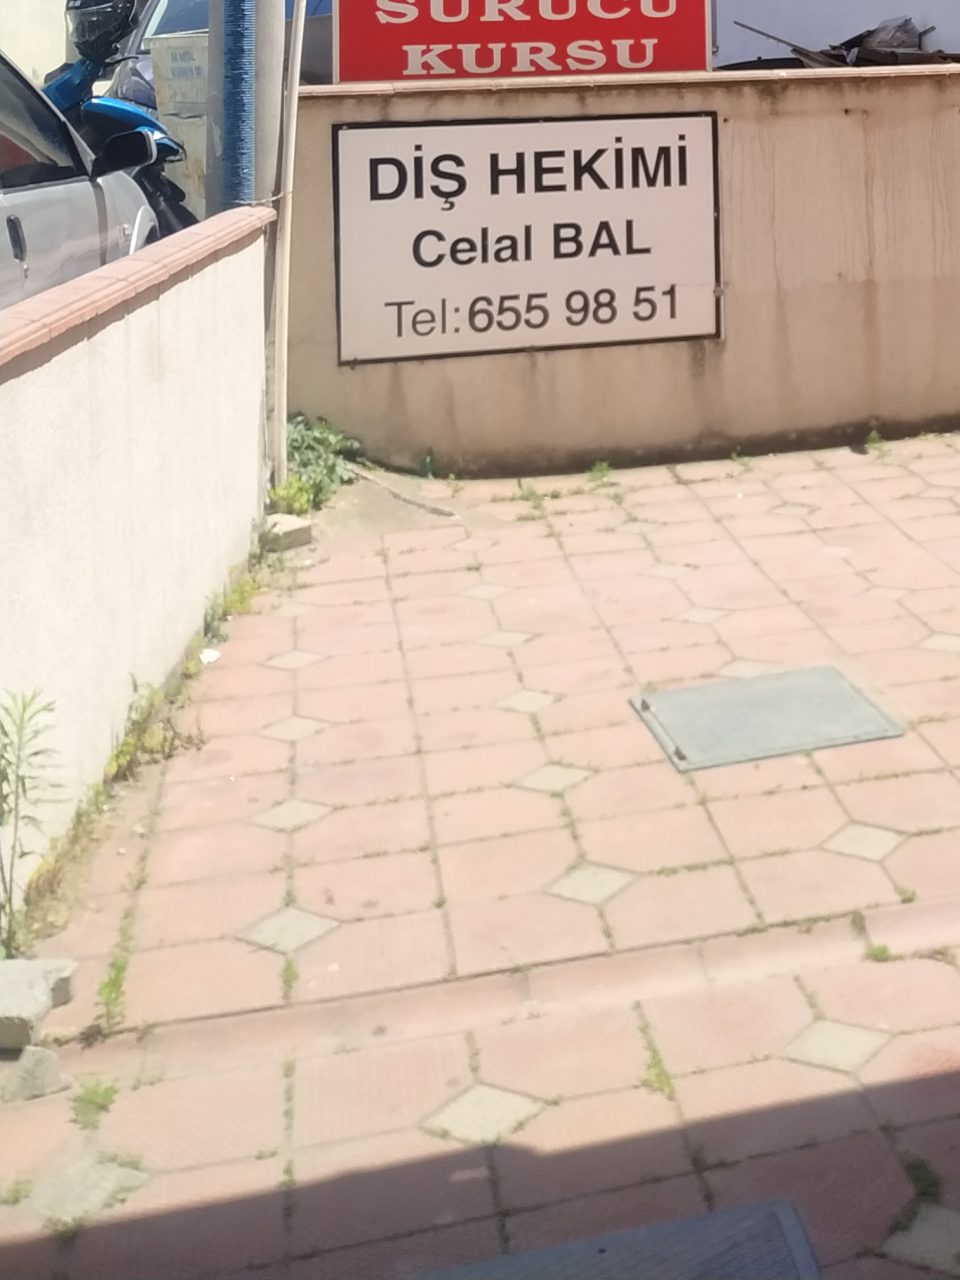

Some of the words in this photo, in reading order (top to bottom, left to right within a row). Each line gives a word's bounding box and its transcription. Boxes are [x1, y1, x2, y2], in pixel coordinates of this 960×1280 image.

[401, 38, 658, 76] KURSU
[368, 144, 468, 211] DİŞ
[489, 134, 688, 195] HEKİMİ
[411, 223, 533, 268] Celal
[552, 219, 652, 260] BAL
[564, 288, 618, 326] 98
[632, 284, 678, 321] 51
